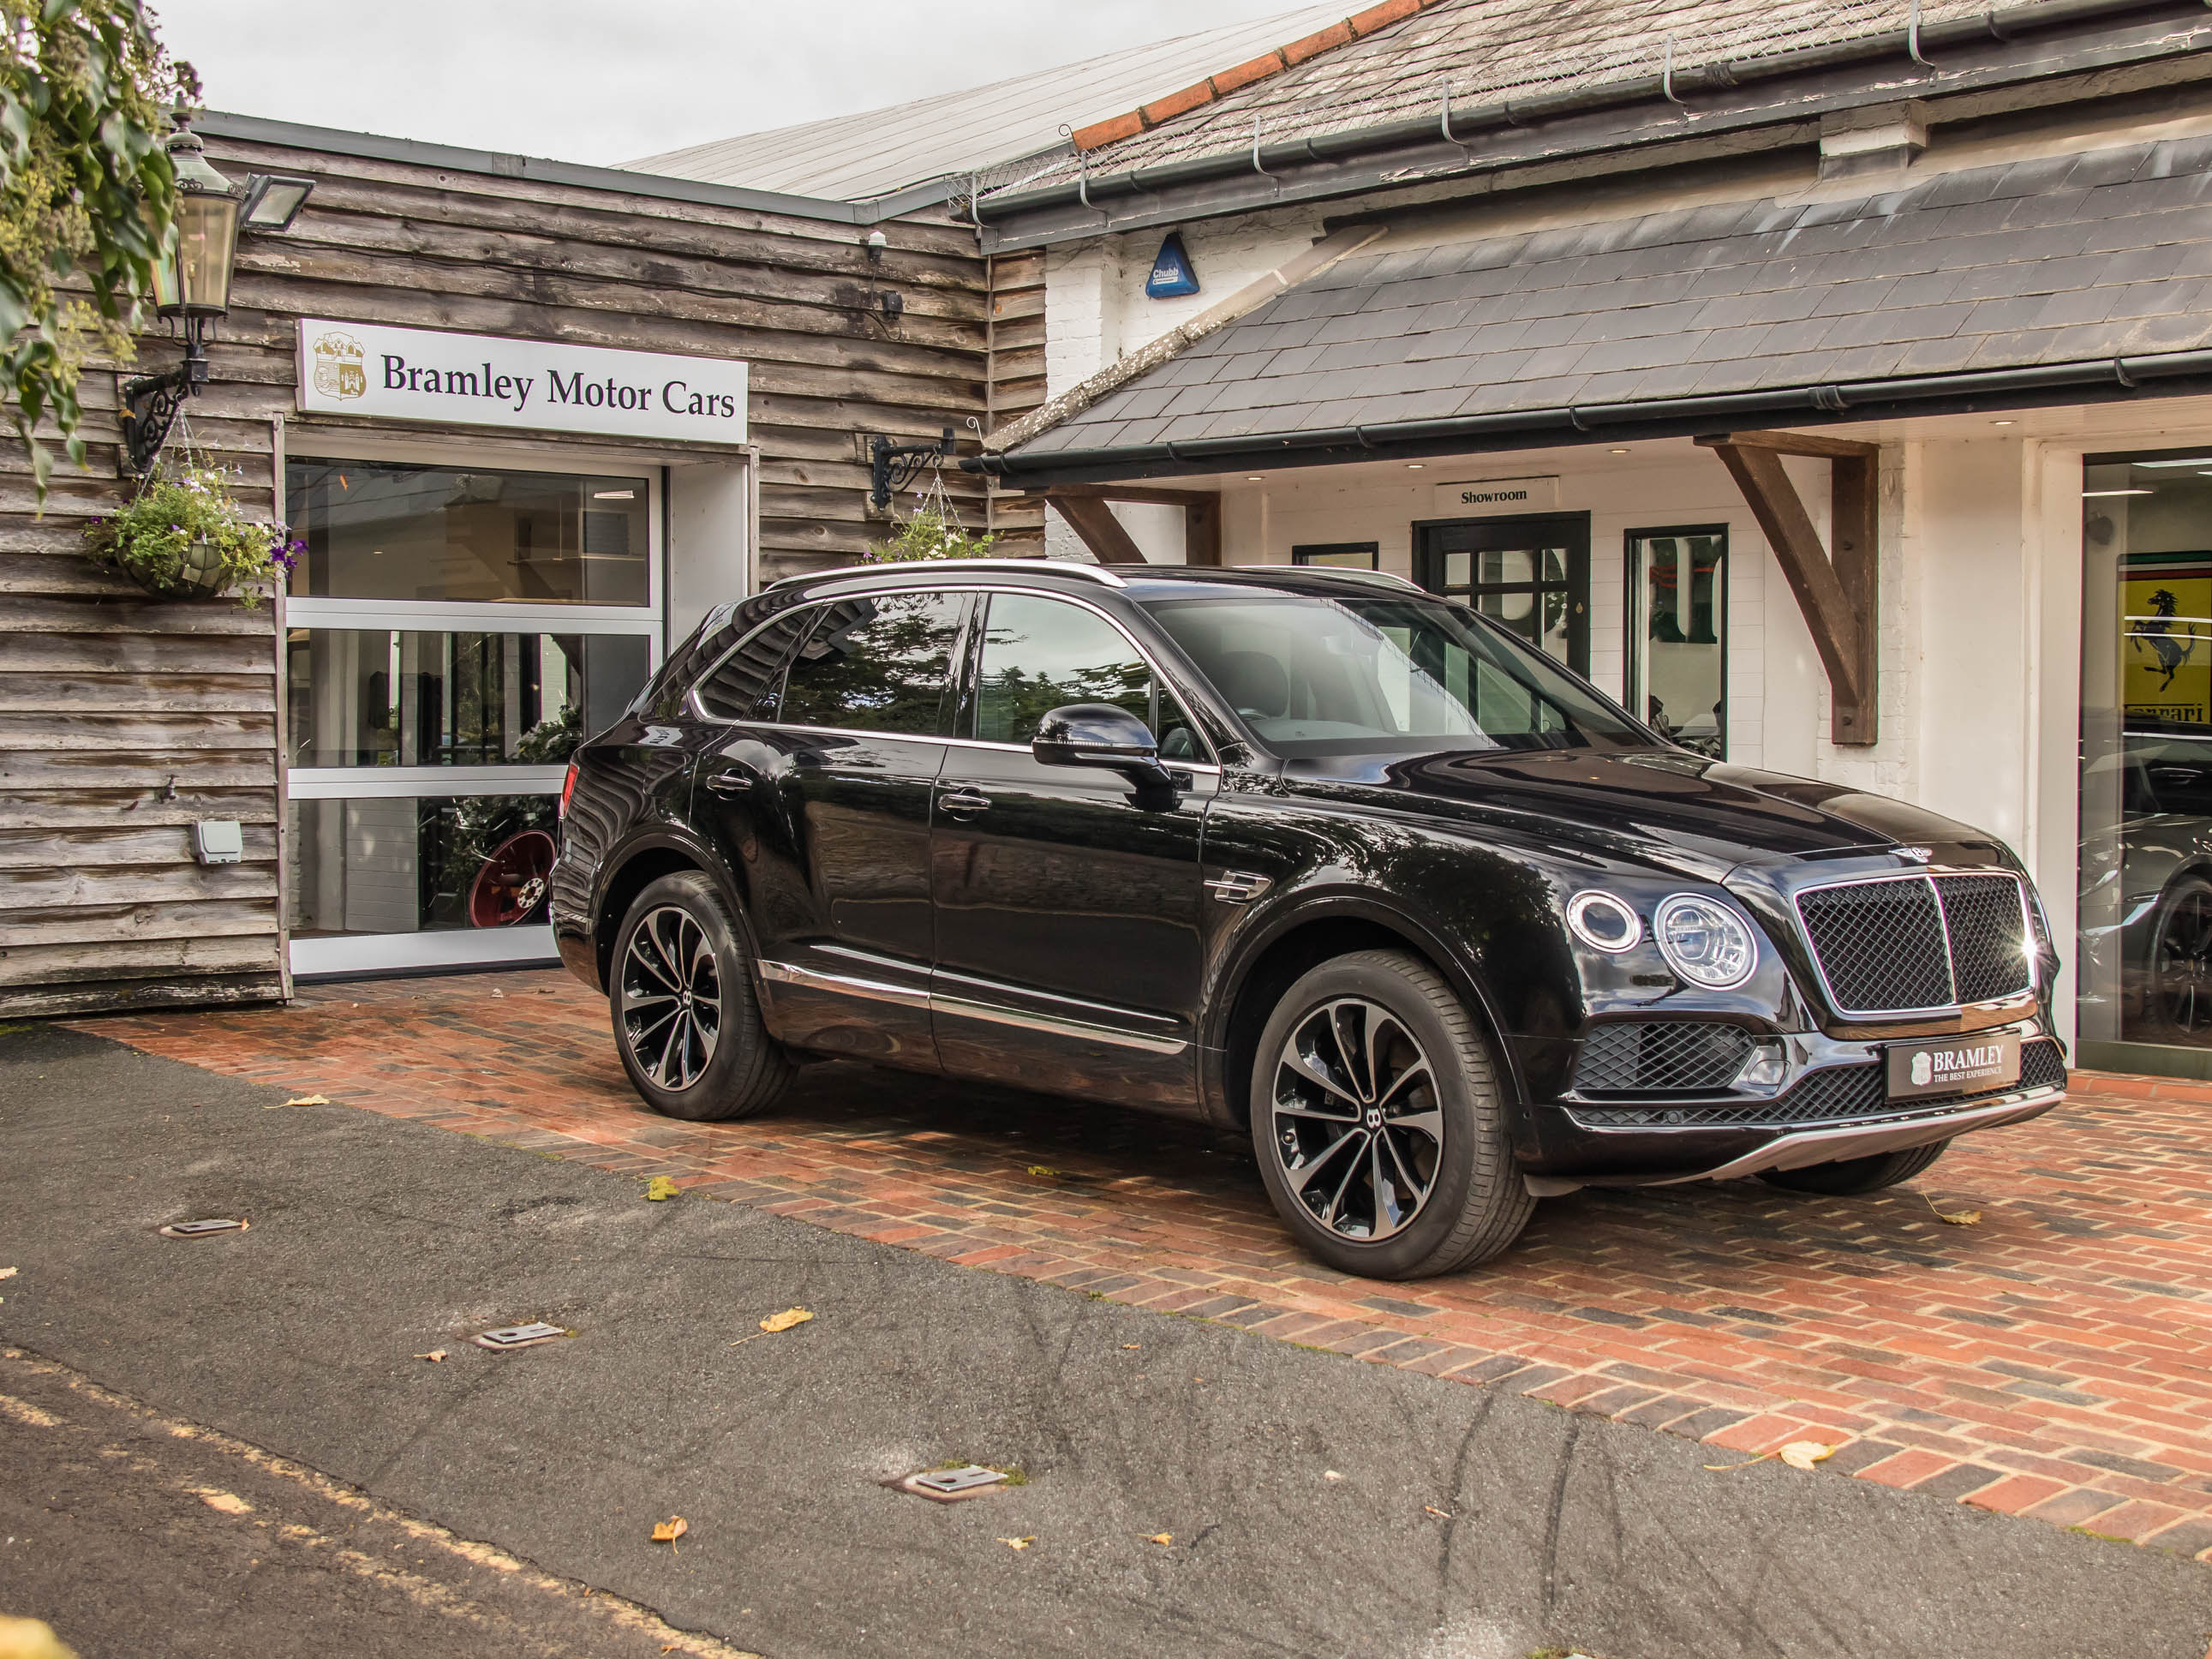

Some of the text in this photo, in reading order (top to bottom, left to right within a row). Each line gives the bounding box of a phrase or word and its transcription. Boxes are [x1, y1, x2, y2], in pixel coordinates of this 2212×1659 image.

[1153, 267, 1179, 278] Chubb
[380, 354, 735, 419] Bramley Motor Cars
[1461, 490, 1527, 504] Showroom
[1933, 1045, 2004, 1072] BRAMLEY
[1934, 1066, 2002, 1083] THE BEST EXPERIENCE
